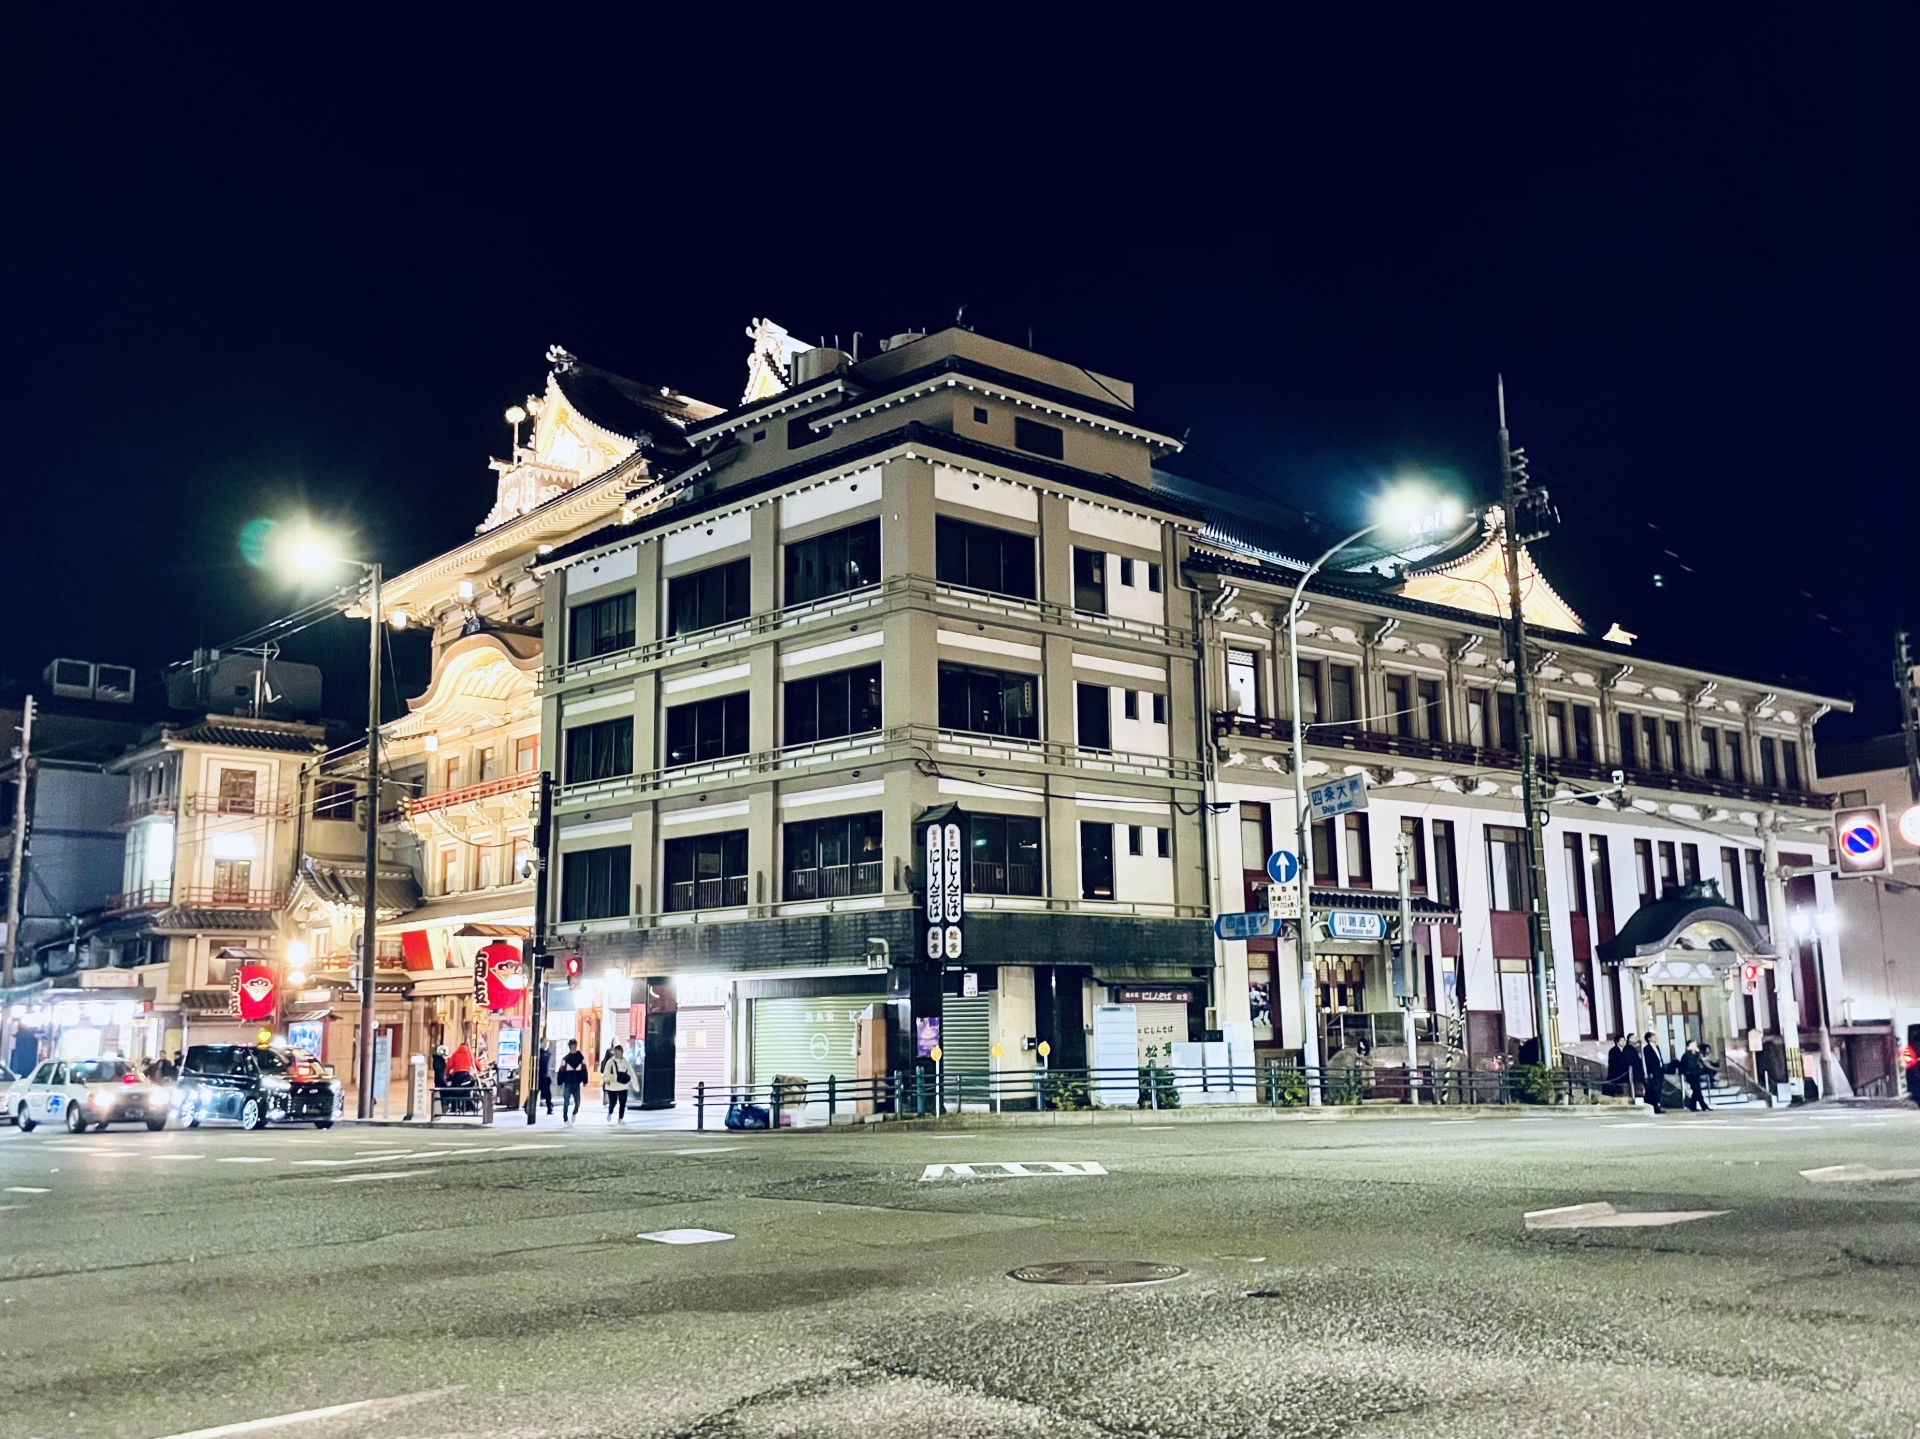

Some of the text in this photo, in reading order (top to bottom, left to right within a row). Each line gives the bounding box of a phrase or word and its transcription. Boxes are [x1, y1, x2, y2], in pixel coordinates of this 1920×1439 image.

[929, 849, 941, 919] にしんそば
[946, 848, 960, 918] にしんそば
[1338, 915, 1376, 928] 川端通り
[948, 930, 959, 954] 松葉
[1142, 991, 1172, 1001] にしんそば
[1143, 1025, 1174, 1035] にしんそば
